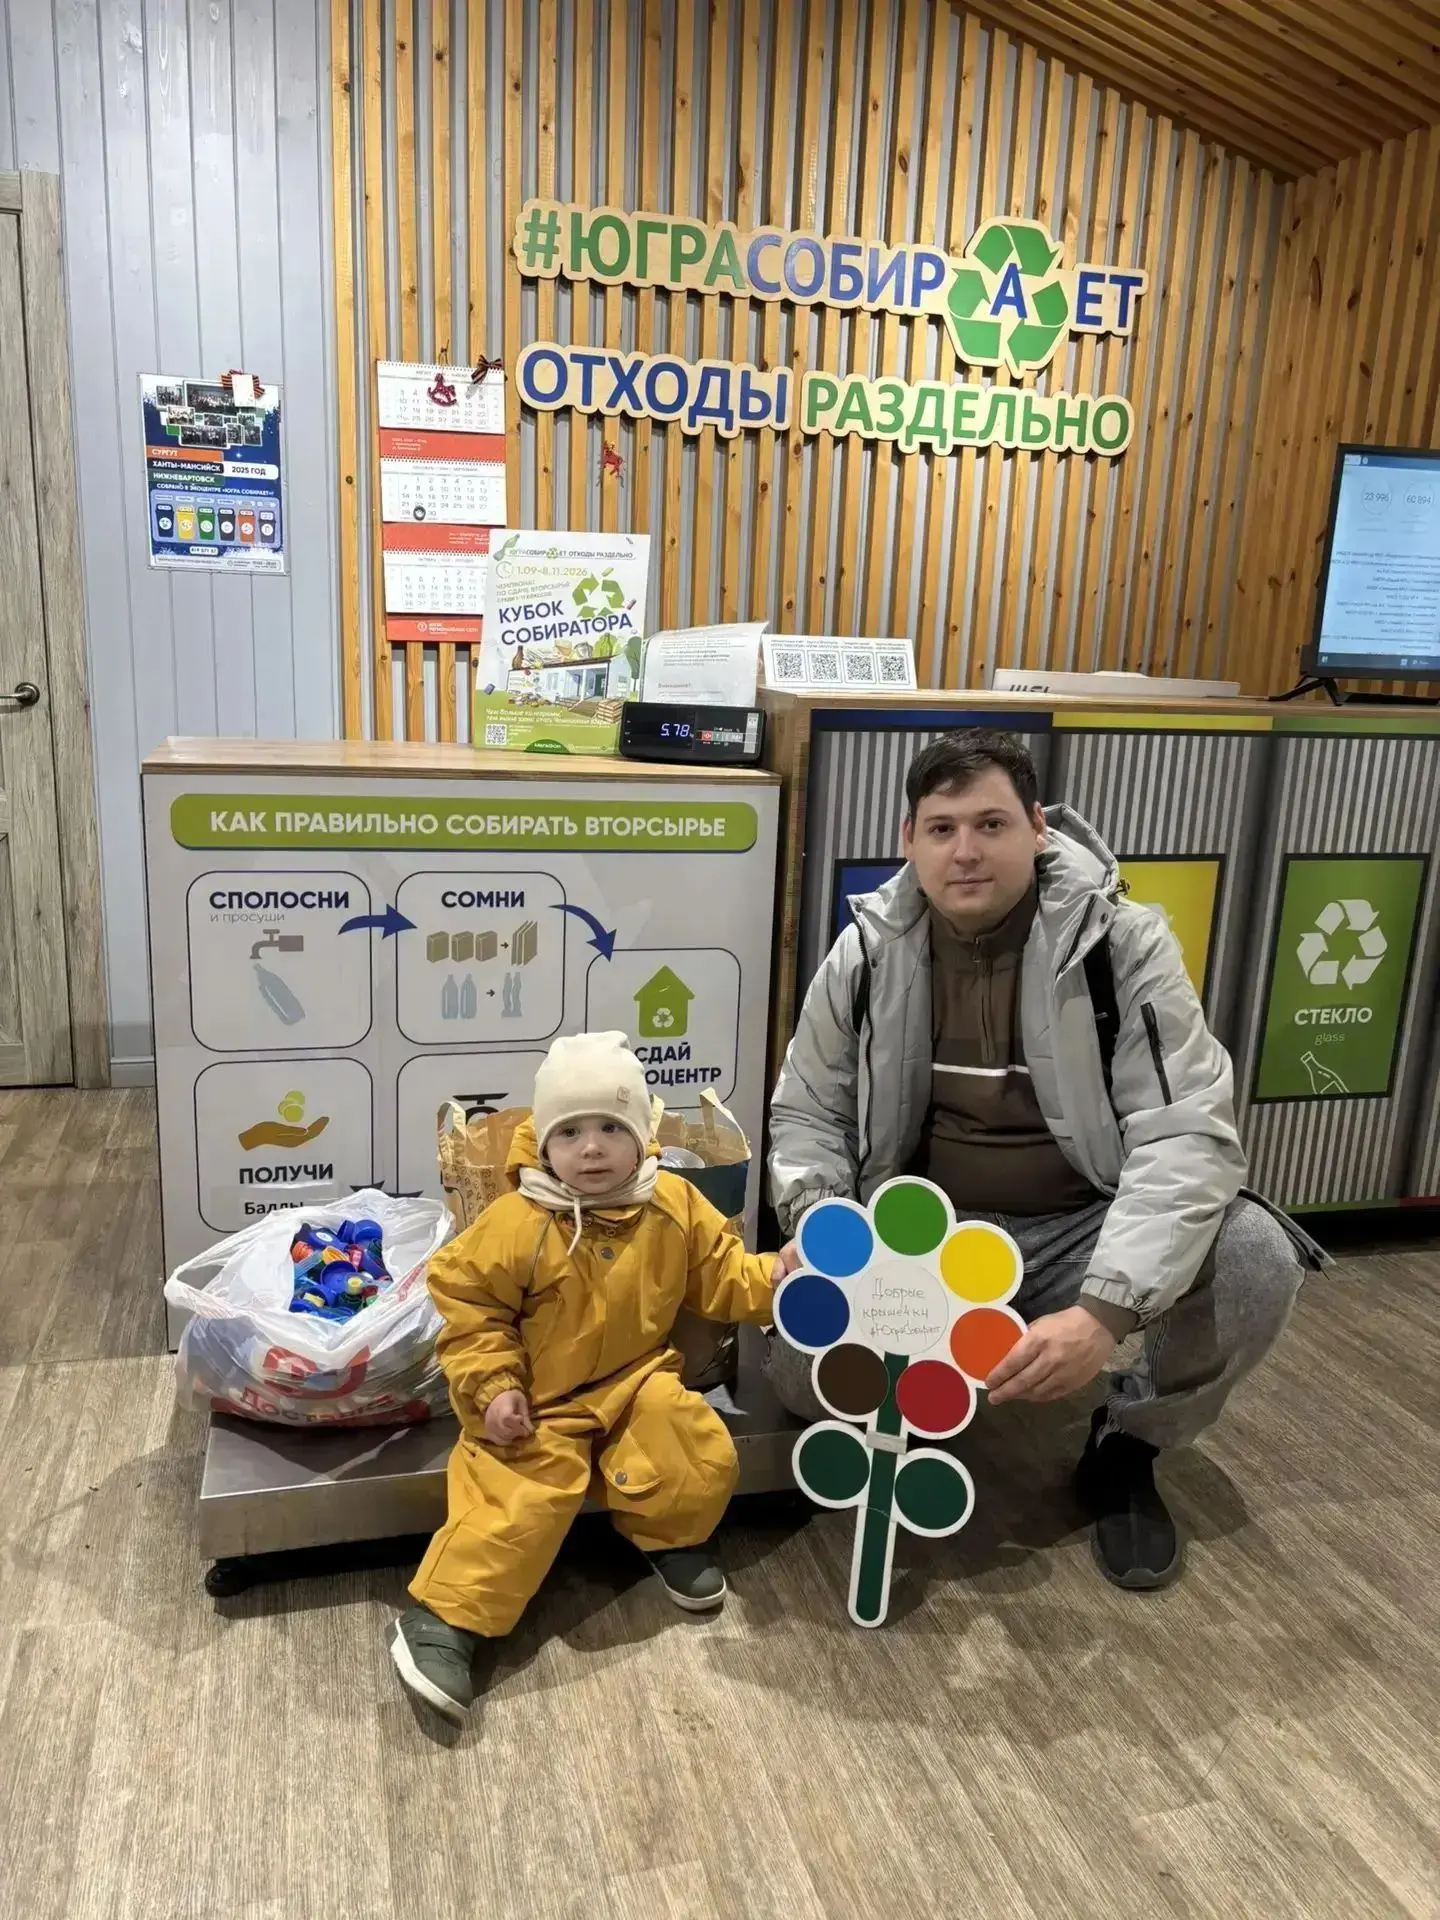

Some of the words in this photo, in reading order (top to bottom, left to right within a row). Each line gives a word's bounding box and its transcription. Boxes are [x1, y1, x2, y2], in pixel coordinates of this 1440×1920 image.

[522, 349, 788, 430] ОТХОДЫ
[807, 378, 1129, 452] РАЗДЕЛЬНО
[231, 466, 249, 474] 2025
[499, 600, 564, 624] КУБОК
[501, 613, 632, 645] СОБИРАТОРА
[210, 811, 267, 833] КАК
[275, 812, 439, 837] ПРАВИЛЬНО
[446, 815, 578, 837] СОБИРАТЬ
[585, 817, 726, 838] ВТОРСЫРЬЕ
[209, 891, 350, 910] СПОЛОСНИ
[441, 891, 525, 908] СОМНИ
[223, 912, 285, 924] просуши
[1294, 1007, 1373, 1026] СТЕКЛО
[1314, 1032, 1345, 1046] glass
[634, 1042, 691, 1064] СДАЙ
[239, 1163, 333, 1184] ПОЛУЧИ
[871, 1277, 925, 1306] Добрые
